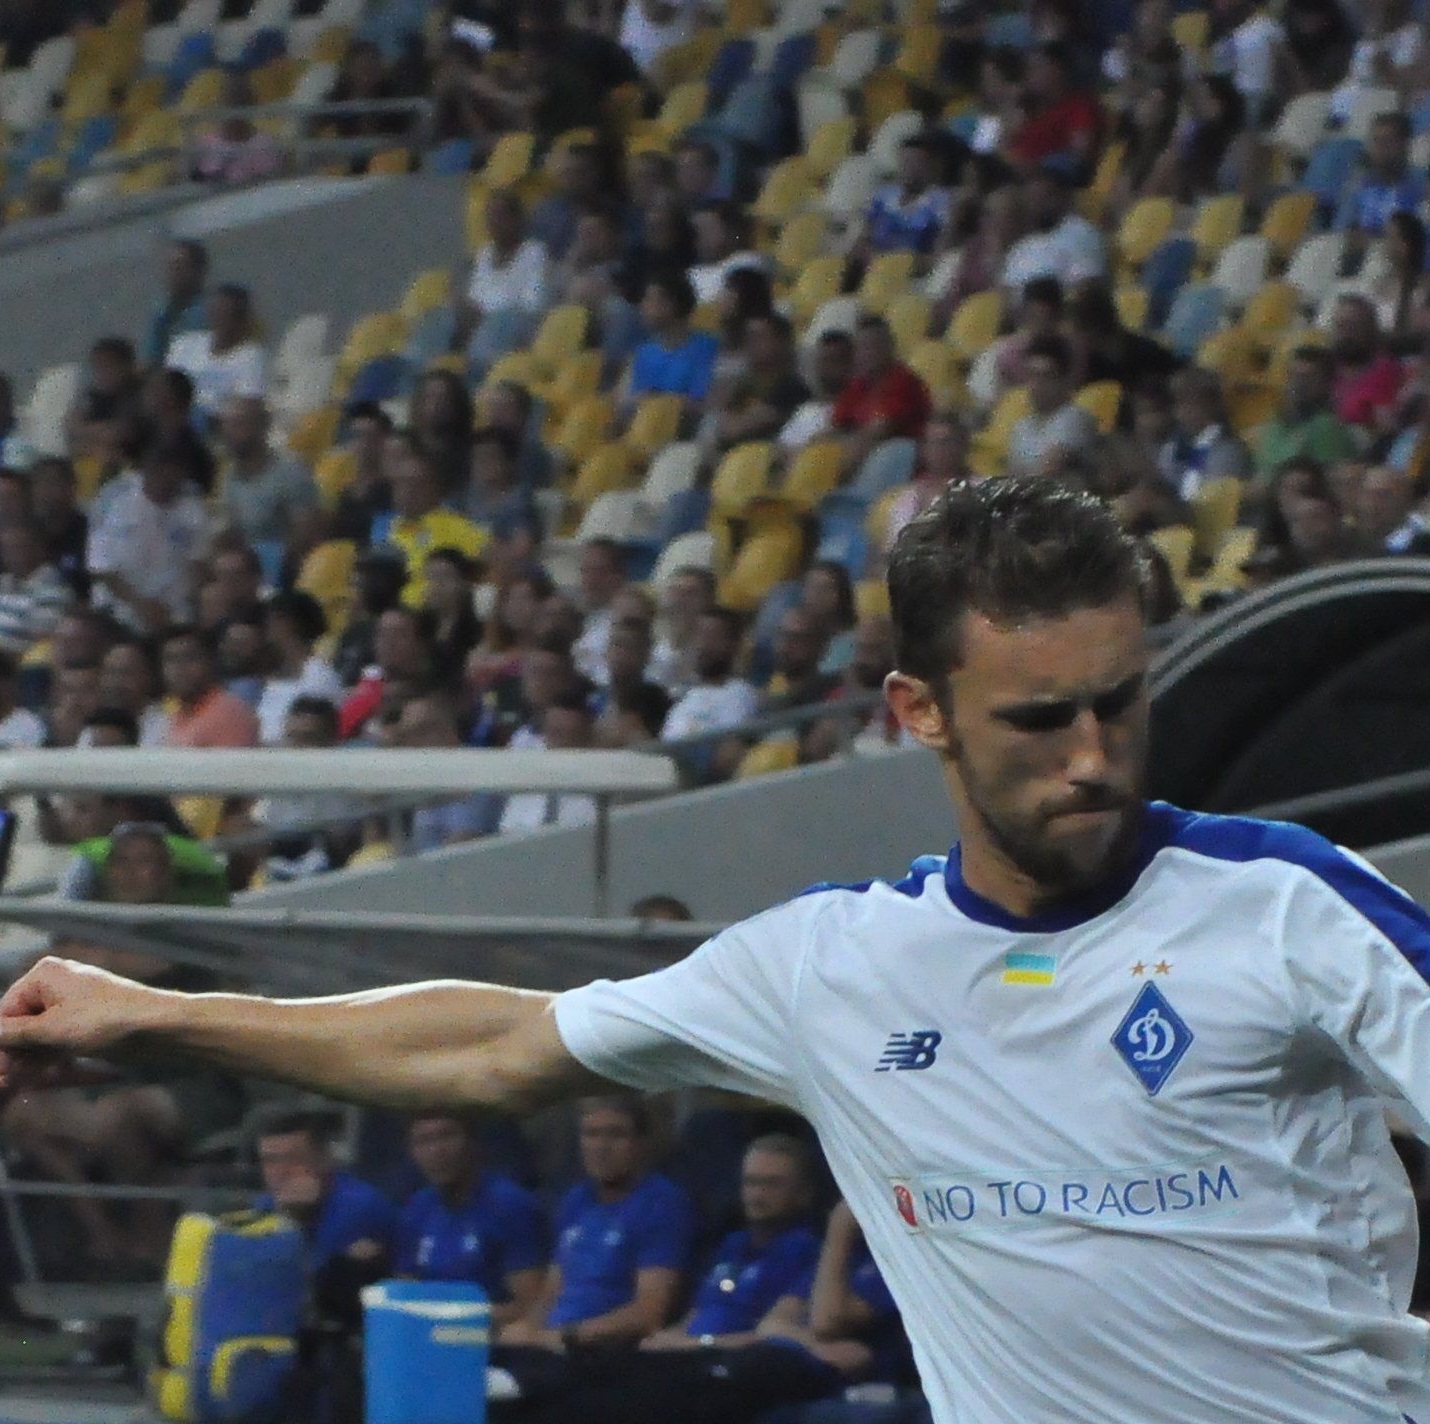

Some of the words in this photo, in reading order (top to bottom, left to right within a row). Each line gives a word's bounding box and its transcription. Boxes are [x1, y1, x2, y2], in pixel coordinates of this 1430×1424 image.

[923, 1185, 975, 1224] NO
[988, 1181, 1047, 1216] TO
[1062, 1165, 1239, 1217] RACISM
